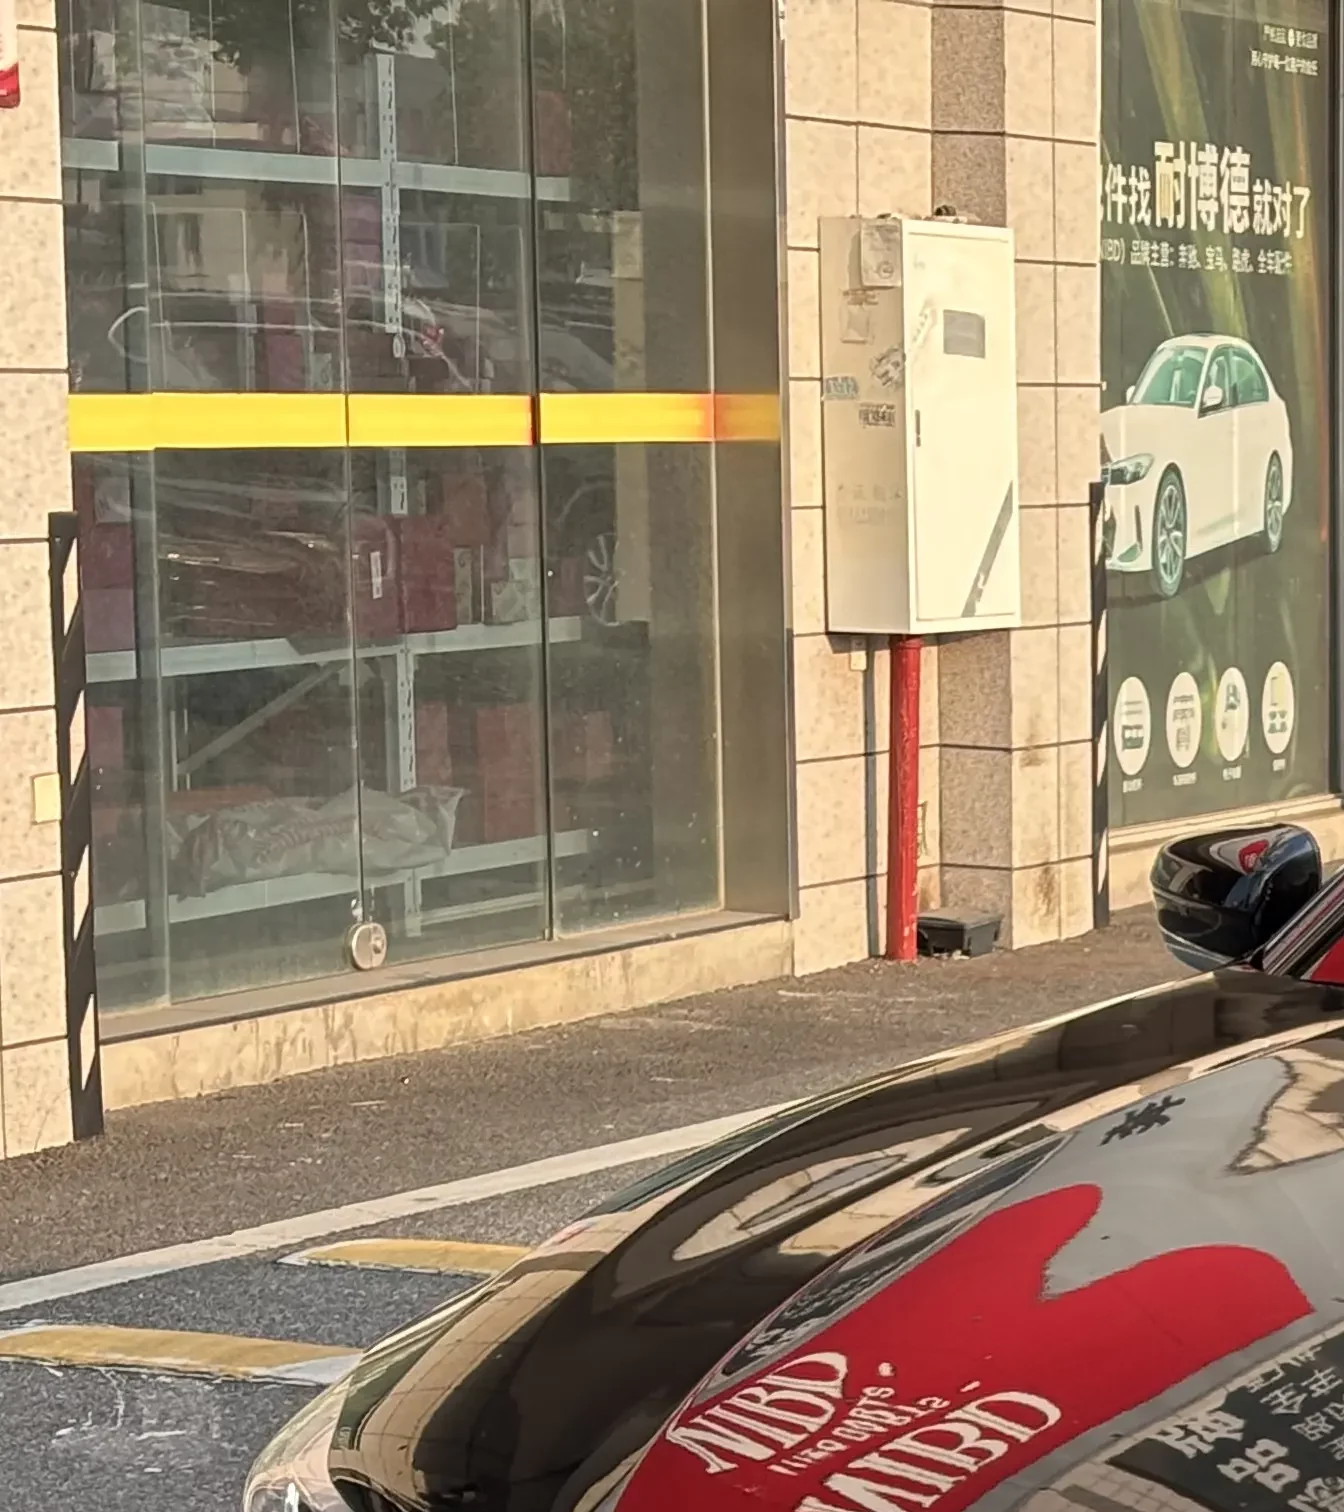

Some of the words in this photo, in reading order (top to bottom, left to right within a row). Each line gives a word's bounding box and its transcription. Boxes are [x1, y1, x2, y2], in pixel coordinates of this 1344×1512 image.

[1101, 140, 1311, 239] 件找耐博德就对了
